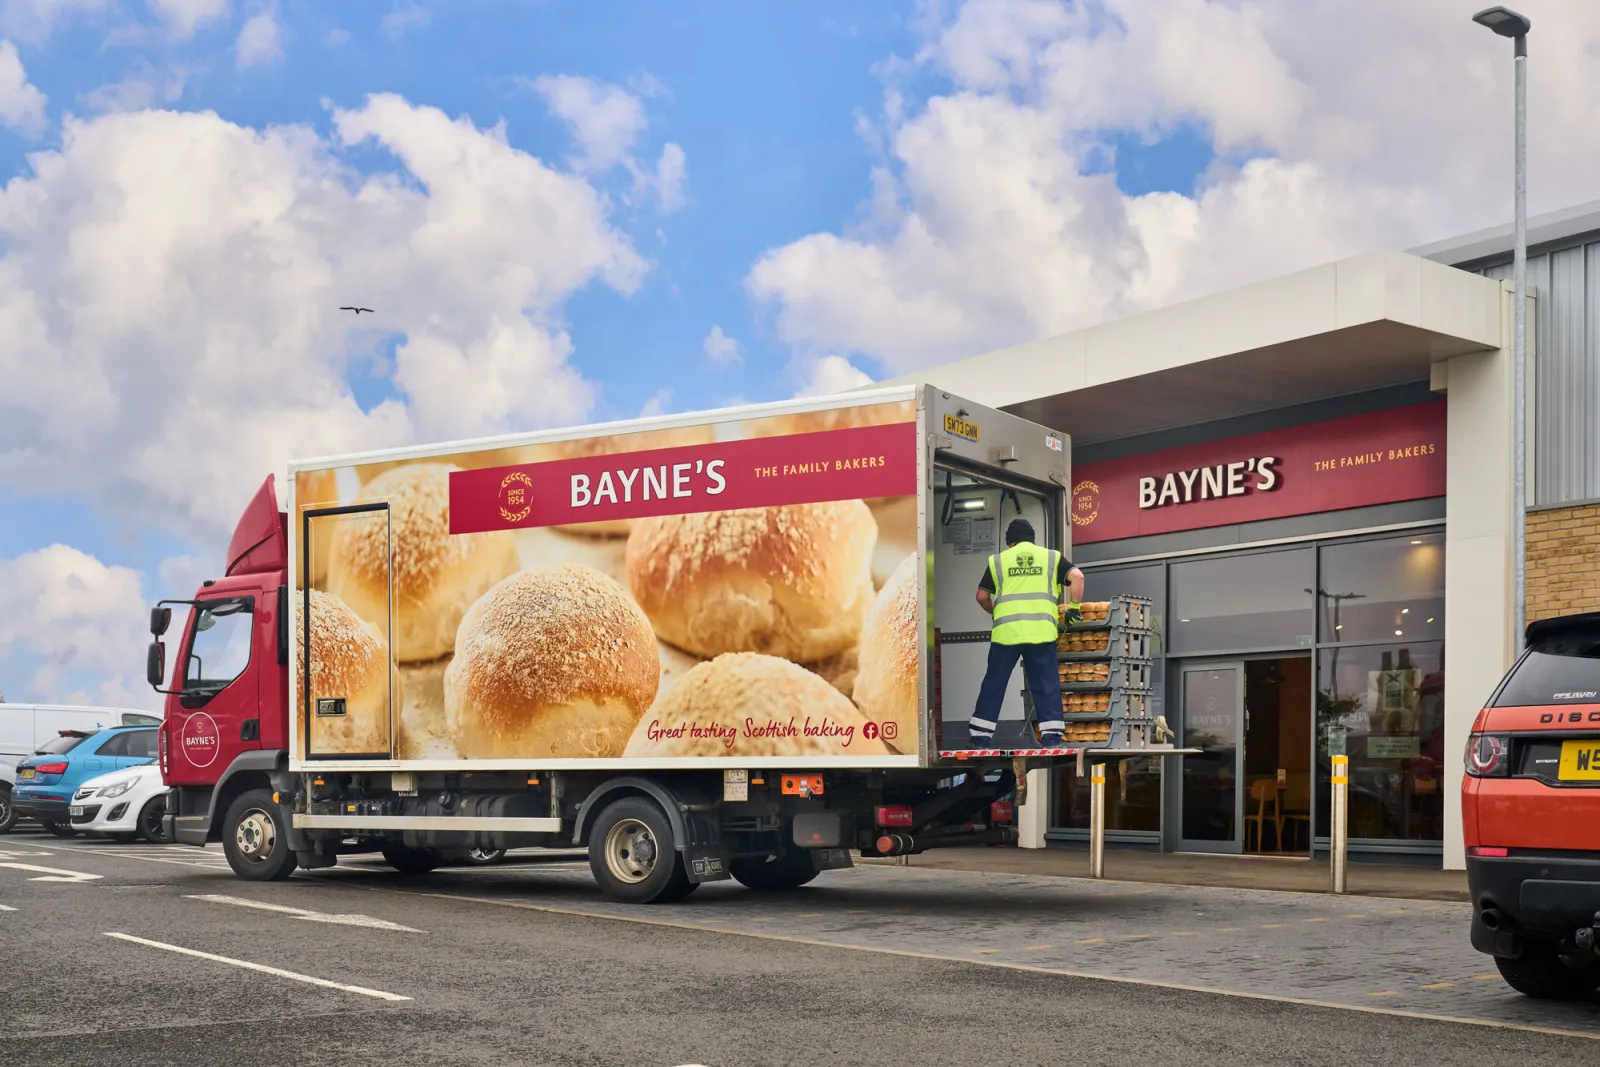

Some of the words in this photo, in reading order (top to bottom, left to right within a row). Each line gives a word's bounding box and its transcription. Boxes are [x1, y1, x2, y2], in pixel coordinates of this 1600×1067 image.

[1315, 459, 1336, 471] THE
[1340, 451, 1383, 467] FAMILY
[1388, 444, 1435, 460] BAKERS
[754, 466, 778, 478] THE
[783, 461, 829, 475] FAMILY
[835, 456, 885, 471] BAKERS
[570, 459, 727, 508] BAYNE'S
[1139, 456, 1276, 509] BAYNE'S
[507, 488, 525, 497] SINCE
[507, 496, 525, 506] 1954
[1078, 495, 1092, 503] SINCE
[1078, 501, 1092, 511] 1954
[1010, 567, 1041, 576] BAYNE'S
[1192, 713, 1231, 725] BAYNE'S
[647, 719, 687, 741] Great
[690, 722, 737, 748] tasting
[742, 717, 798, 738] Scottish
[803, 716, 855, 747] baking
[186, 736, 215, 746] BAYNE'S
